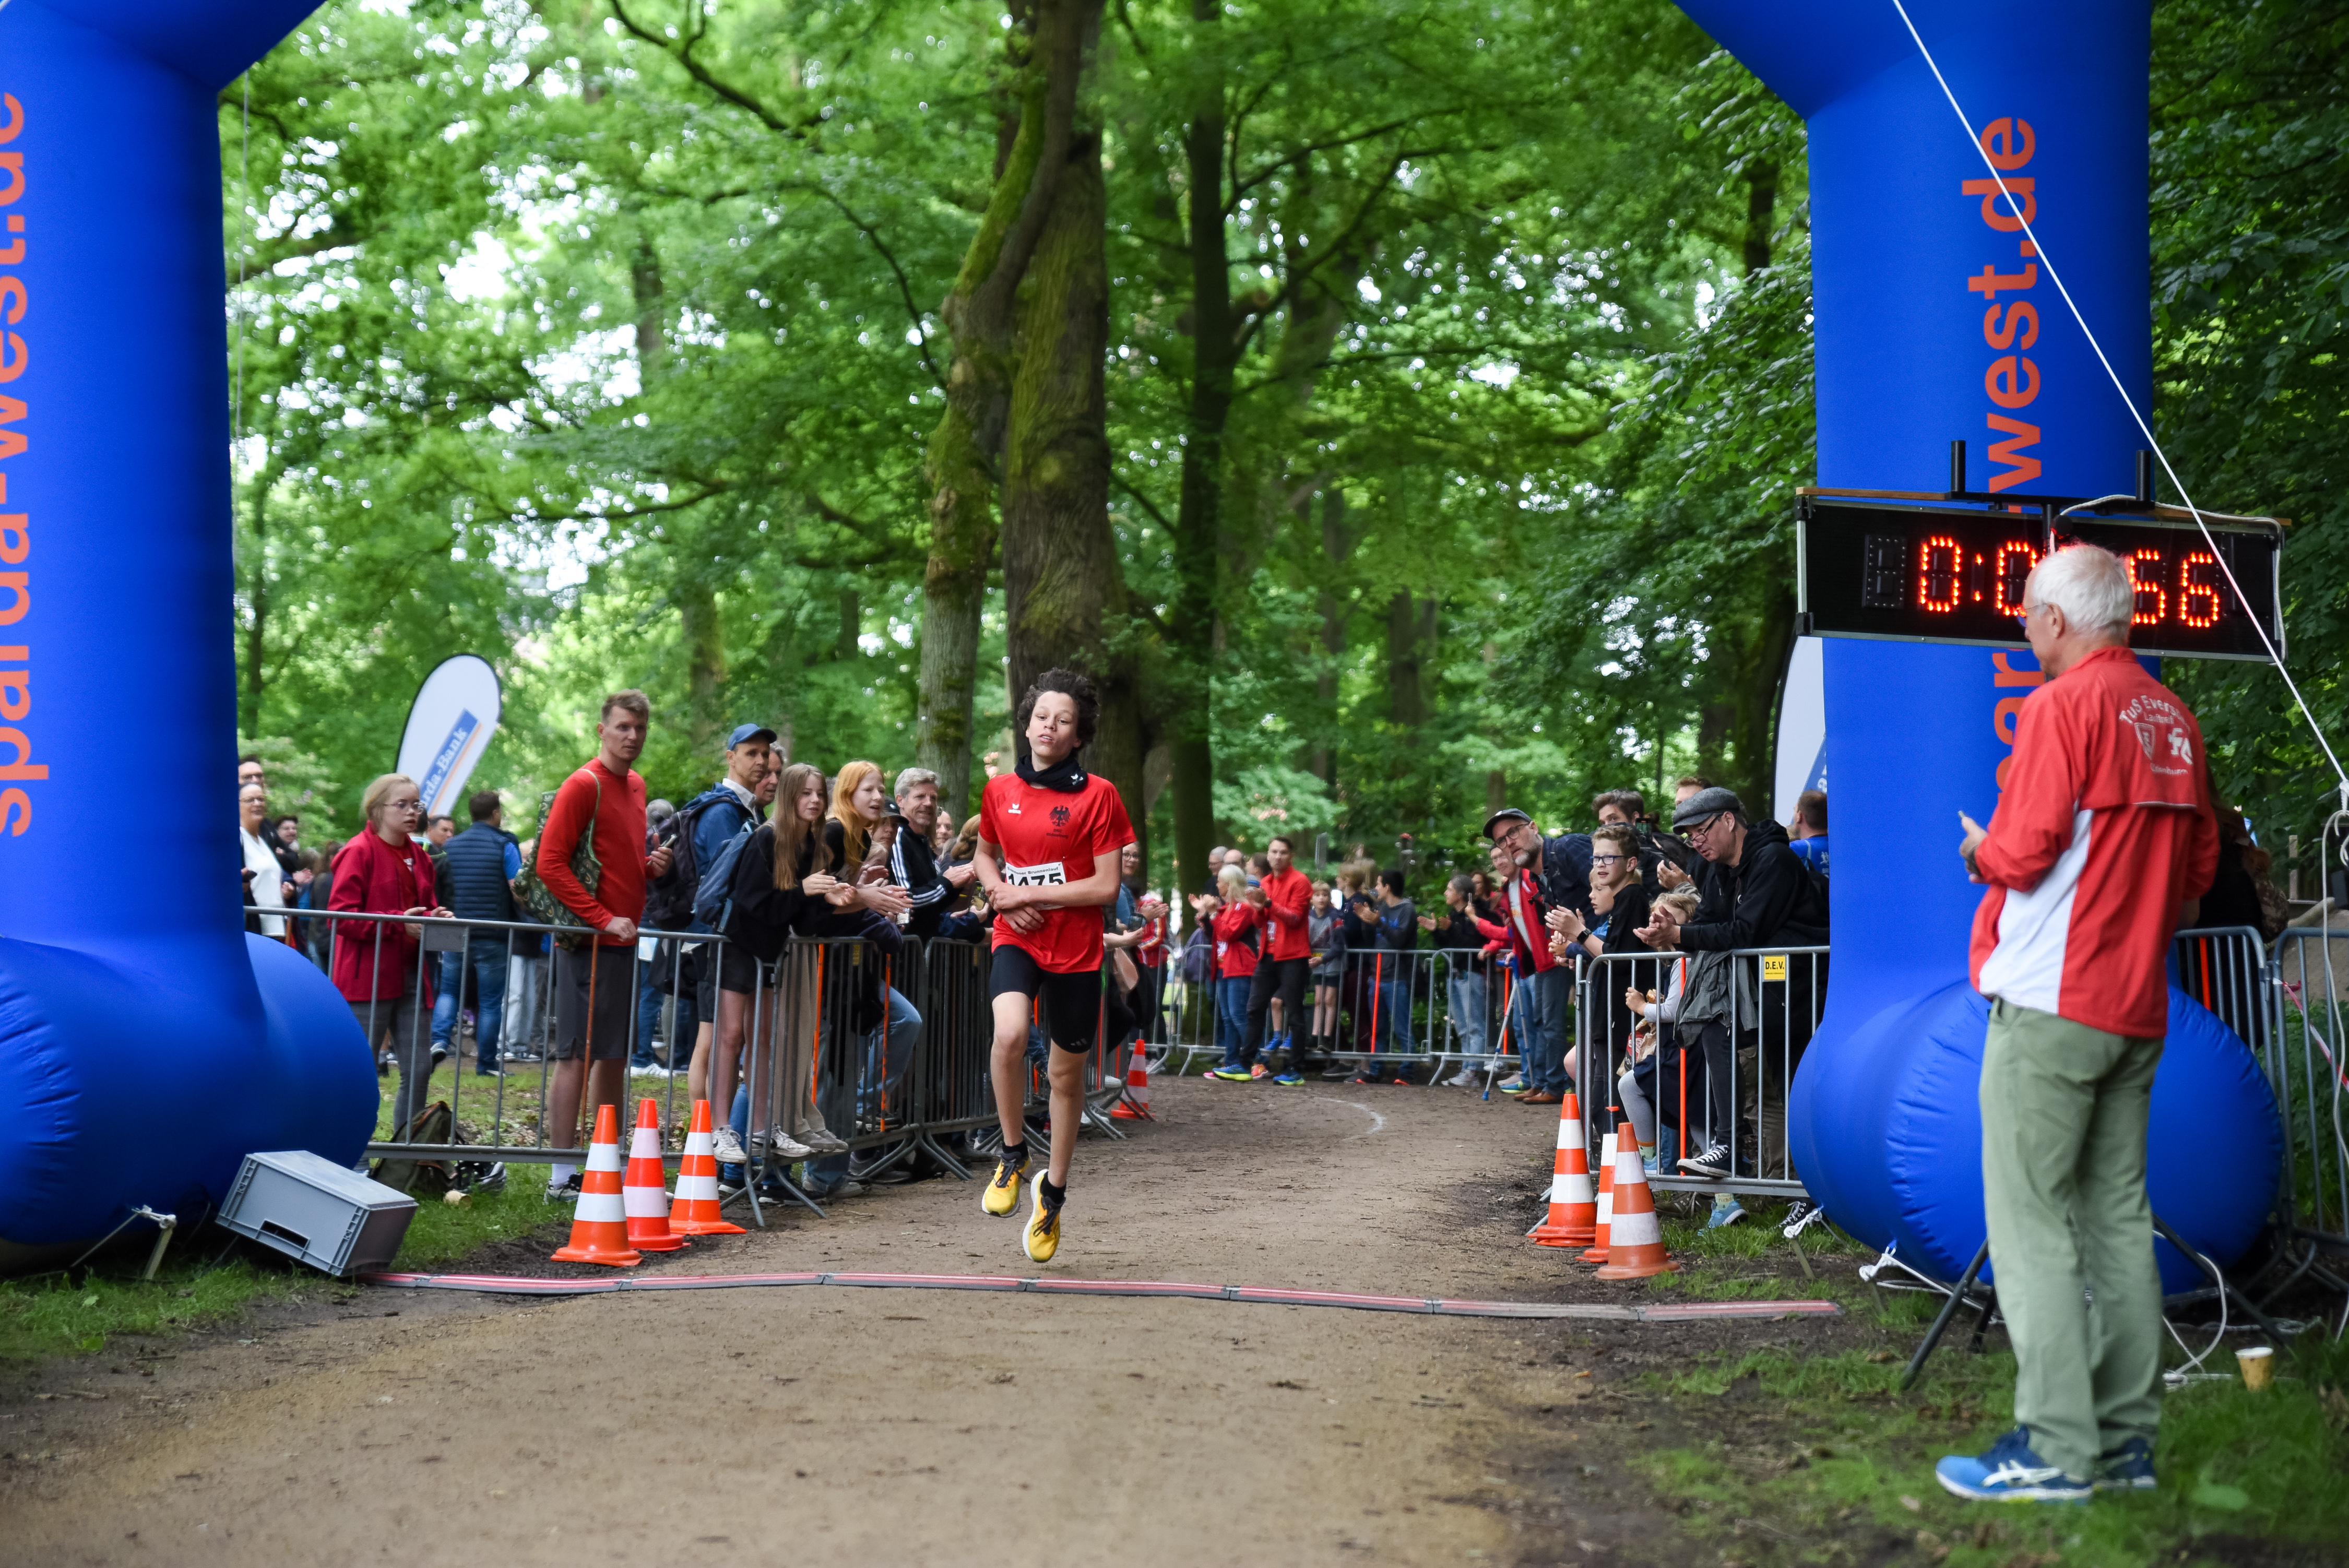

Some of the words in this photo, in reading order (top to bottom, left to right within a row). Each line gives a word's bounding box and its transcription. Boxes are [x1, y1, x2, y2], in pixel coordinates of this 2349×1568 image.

[2141, 695, 2191, 732] Evers
[419, 728, 467, 809] rda-Bank
[1765, 961, 1785, 970] D.E.V.
